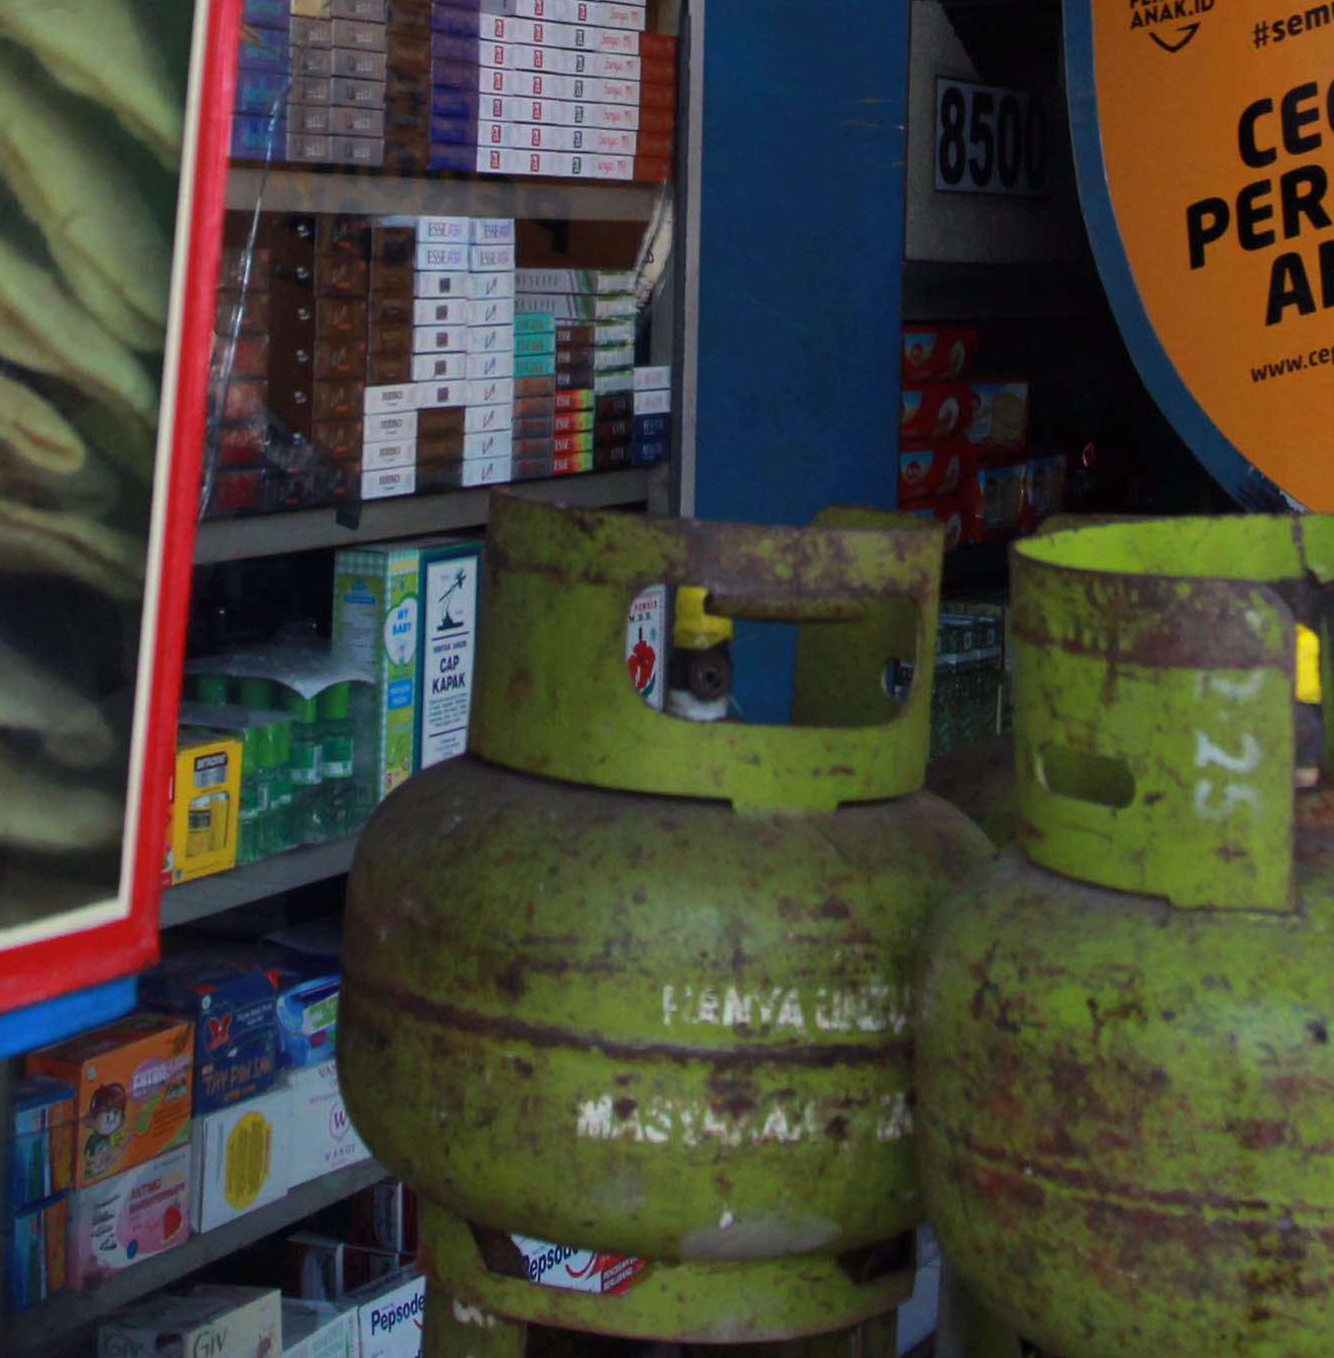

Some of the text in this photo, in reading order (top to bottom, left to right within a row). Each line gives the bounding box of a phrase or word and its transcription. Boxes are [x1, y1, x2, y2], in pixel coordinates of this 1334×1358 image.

[938, 87, 1047, 189] 8500
[439, 655, 460, 673] CAP
[432, 672, 467, 695] KAPAK
[371, 1292, 426, 1336] Pepsode
